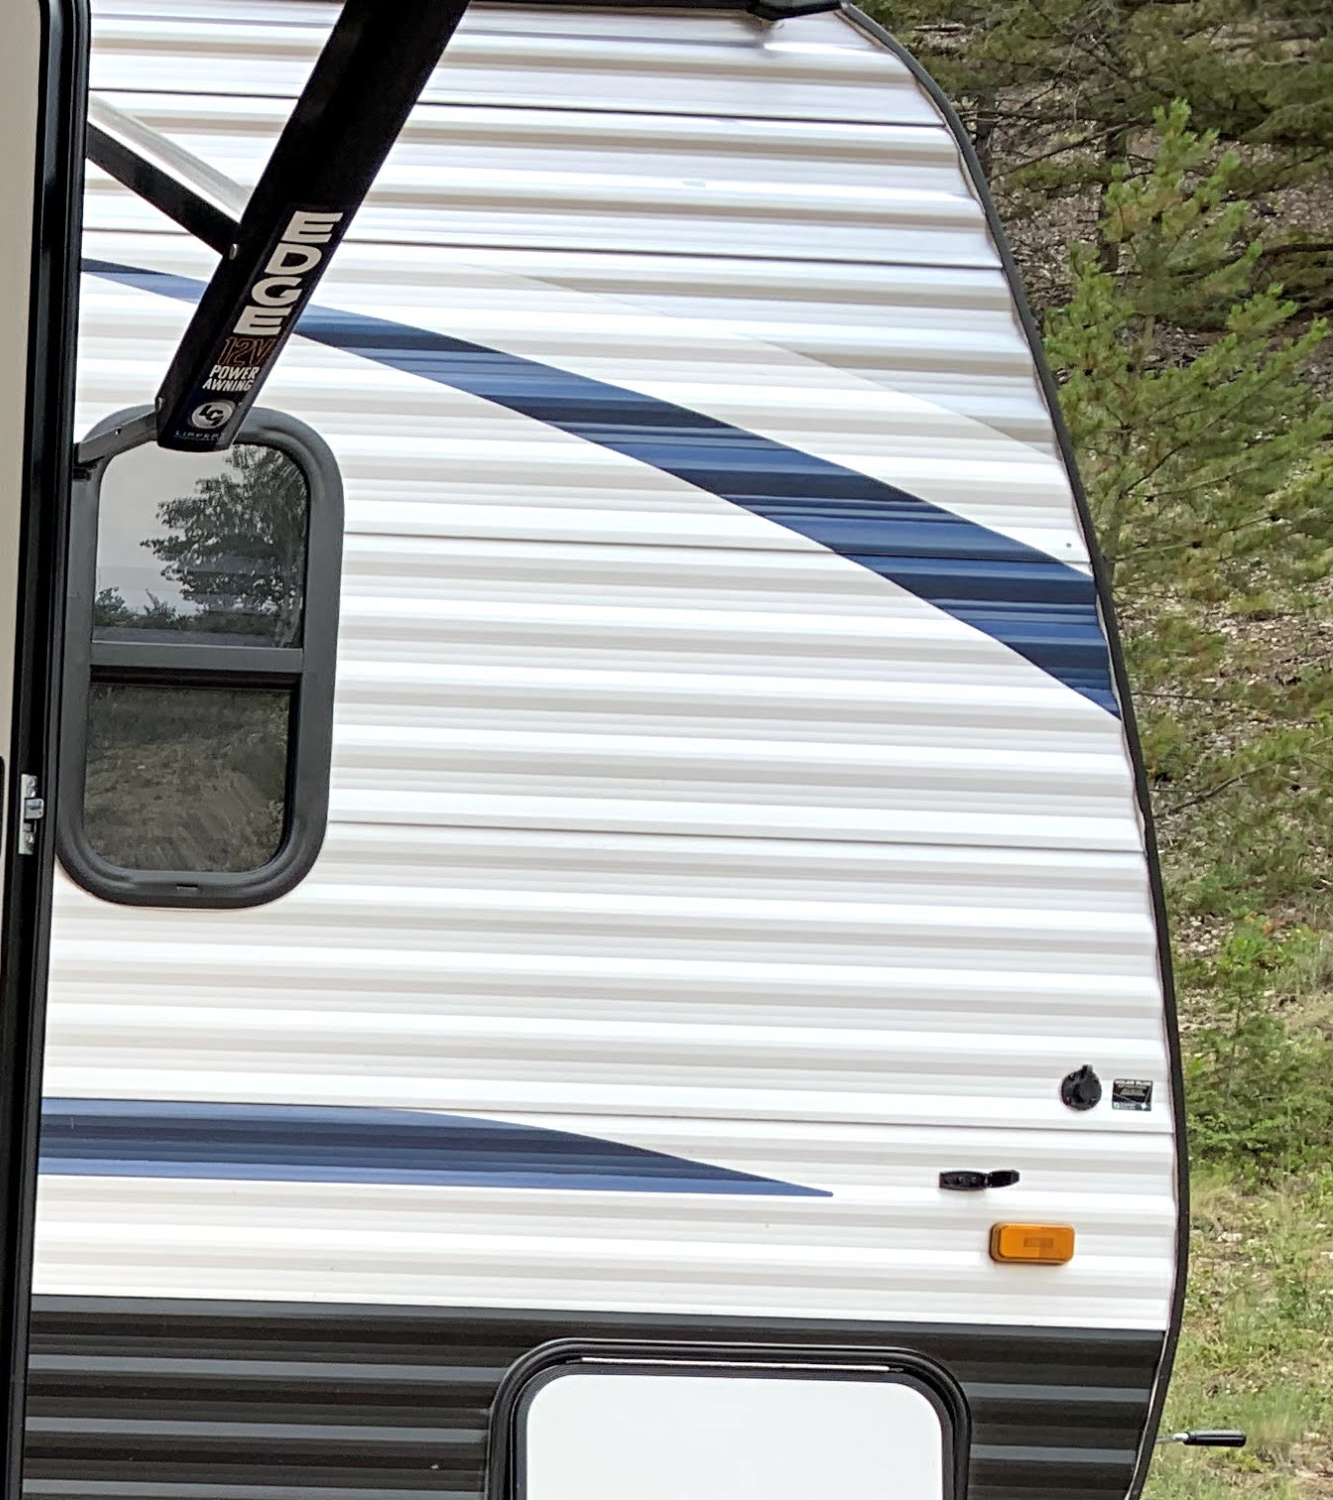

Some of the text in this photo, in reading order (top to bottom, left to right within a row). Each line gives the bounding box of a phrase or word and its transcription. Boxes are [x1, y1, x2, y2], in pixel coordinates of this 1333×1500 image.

[233, 210, 344, 336] EDGE
[217, 337, 276, 367] 12V
[209, 365, 260, 380] POWER
[202, 378, 254, 391] AWNING
